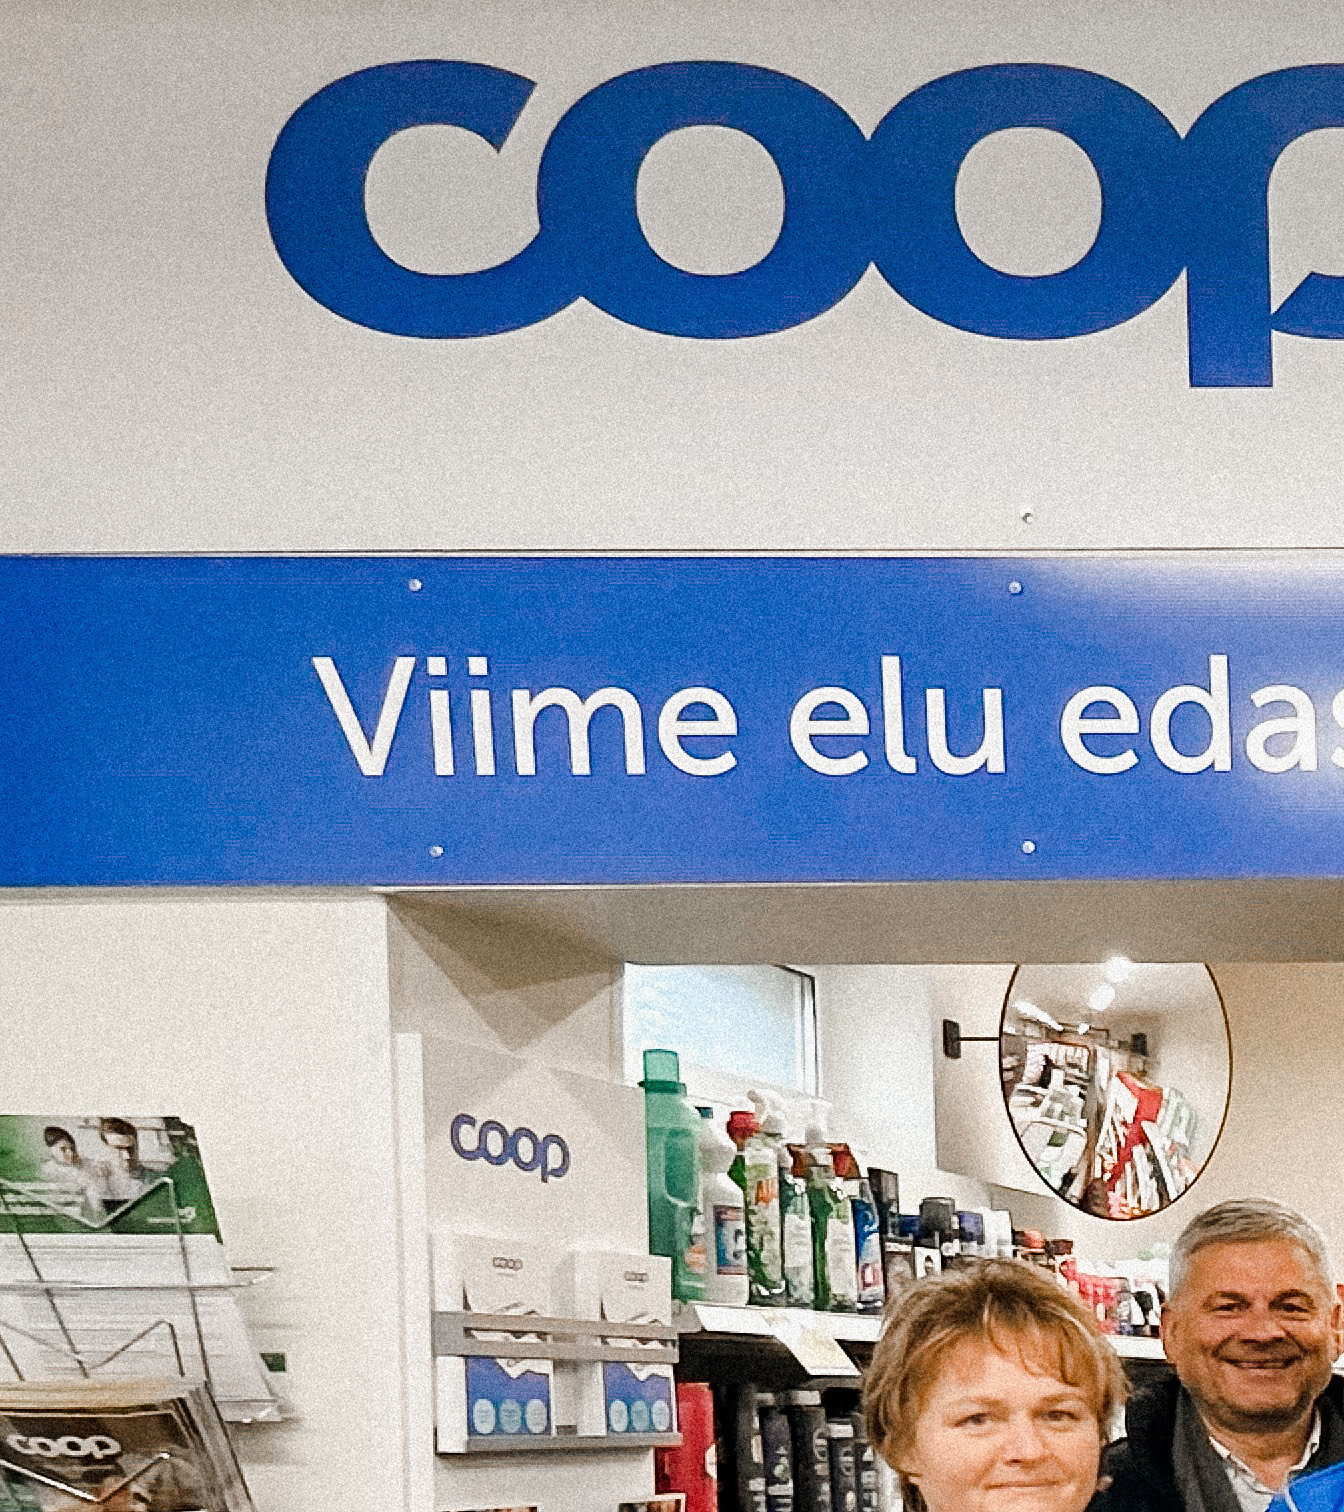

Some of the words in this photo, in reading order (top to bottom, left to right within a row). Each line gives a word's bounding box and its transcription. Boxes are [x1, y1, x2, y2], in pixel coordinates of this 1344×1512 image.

[312, 655, 738, 777] Viime
[789, 655, 1005, 777] elu
[450, 1113, 572, 1184] coop
[7, 1434, 122, 1459] coop
